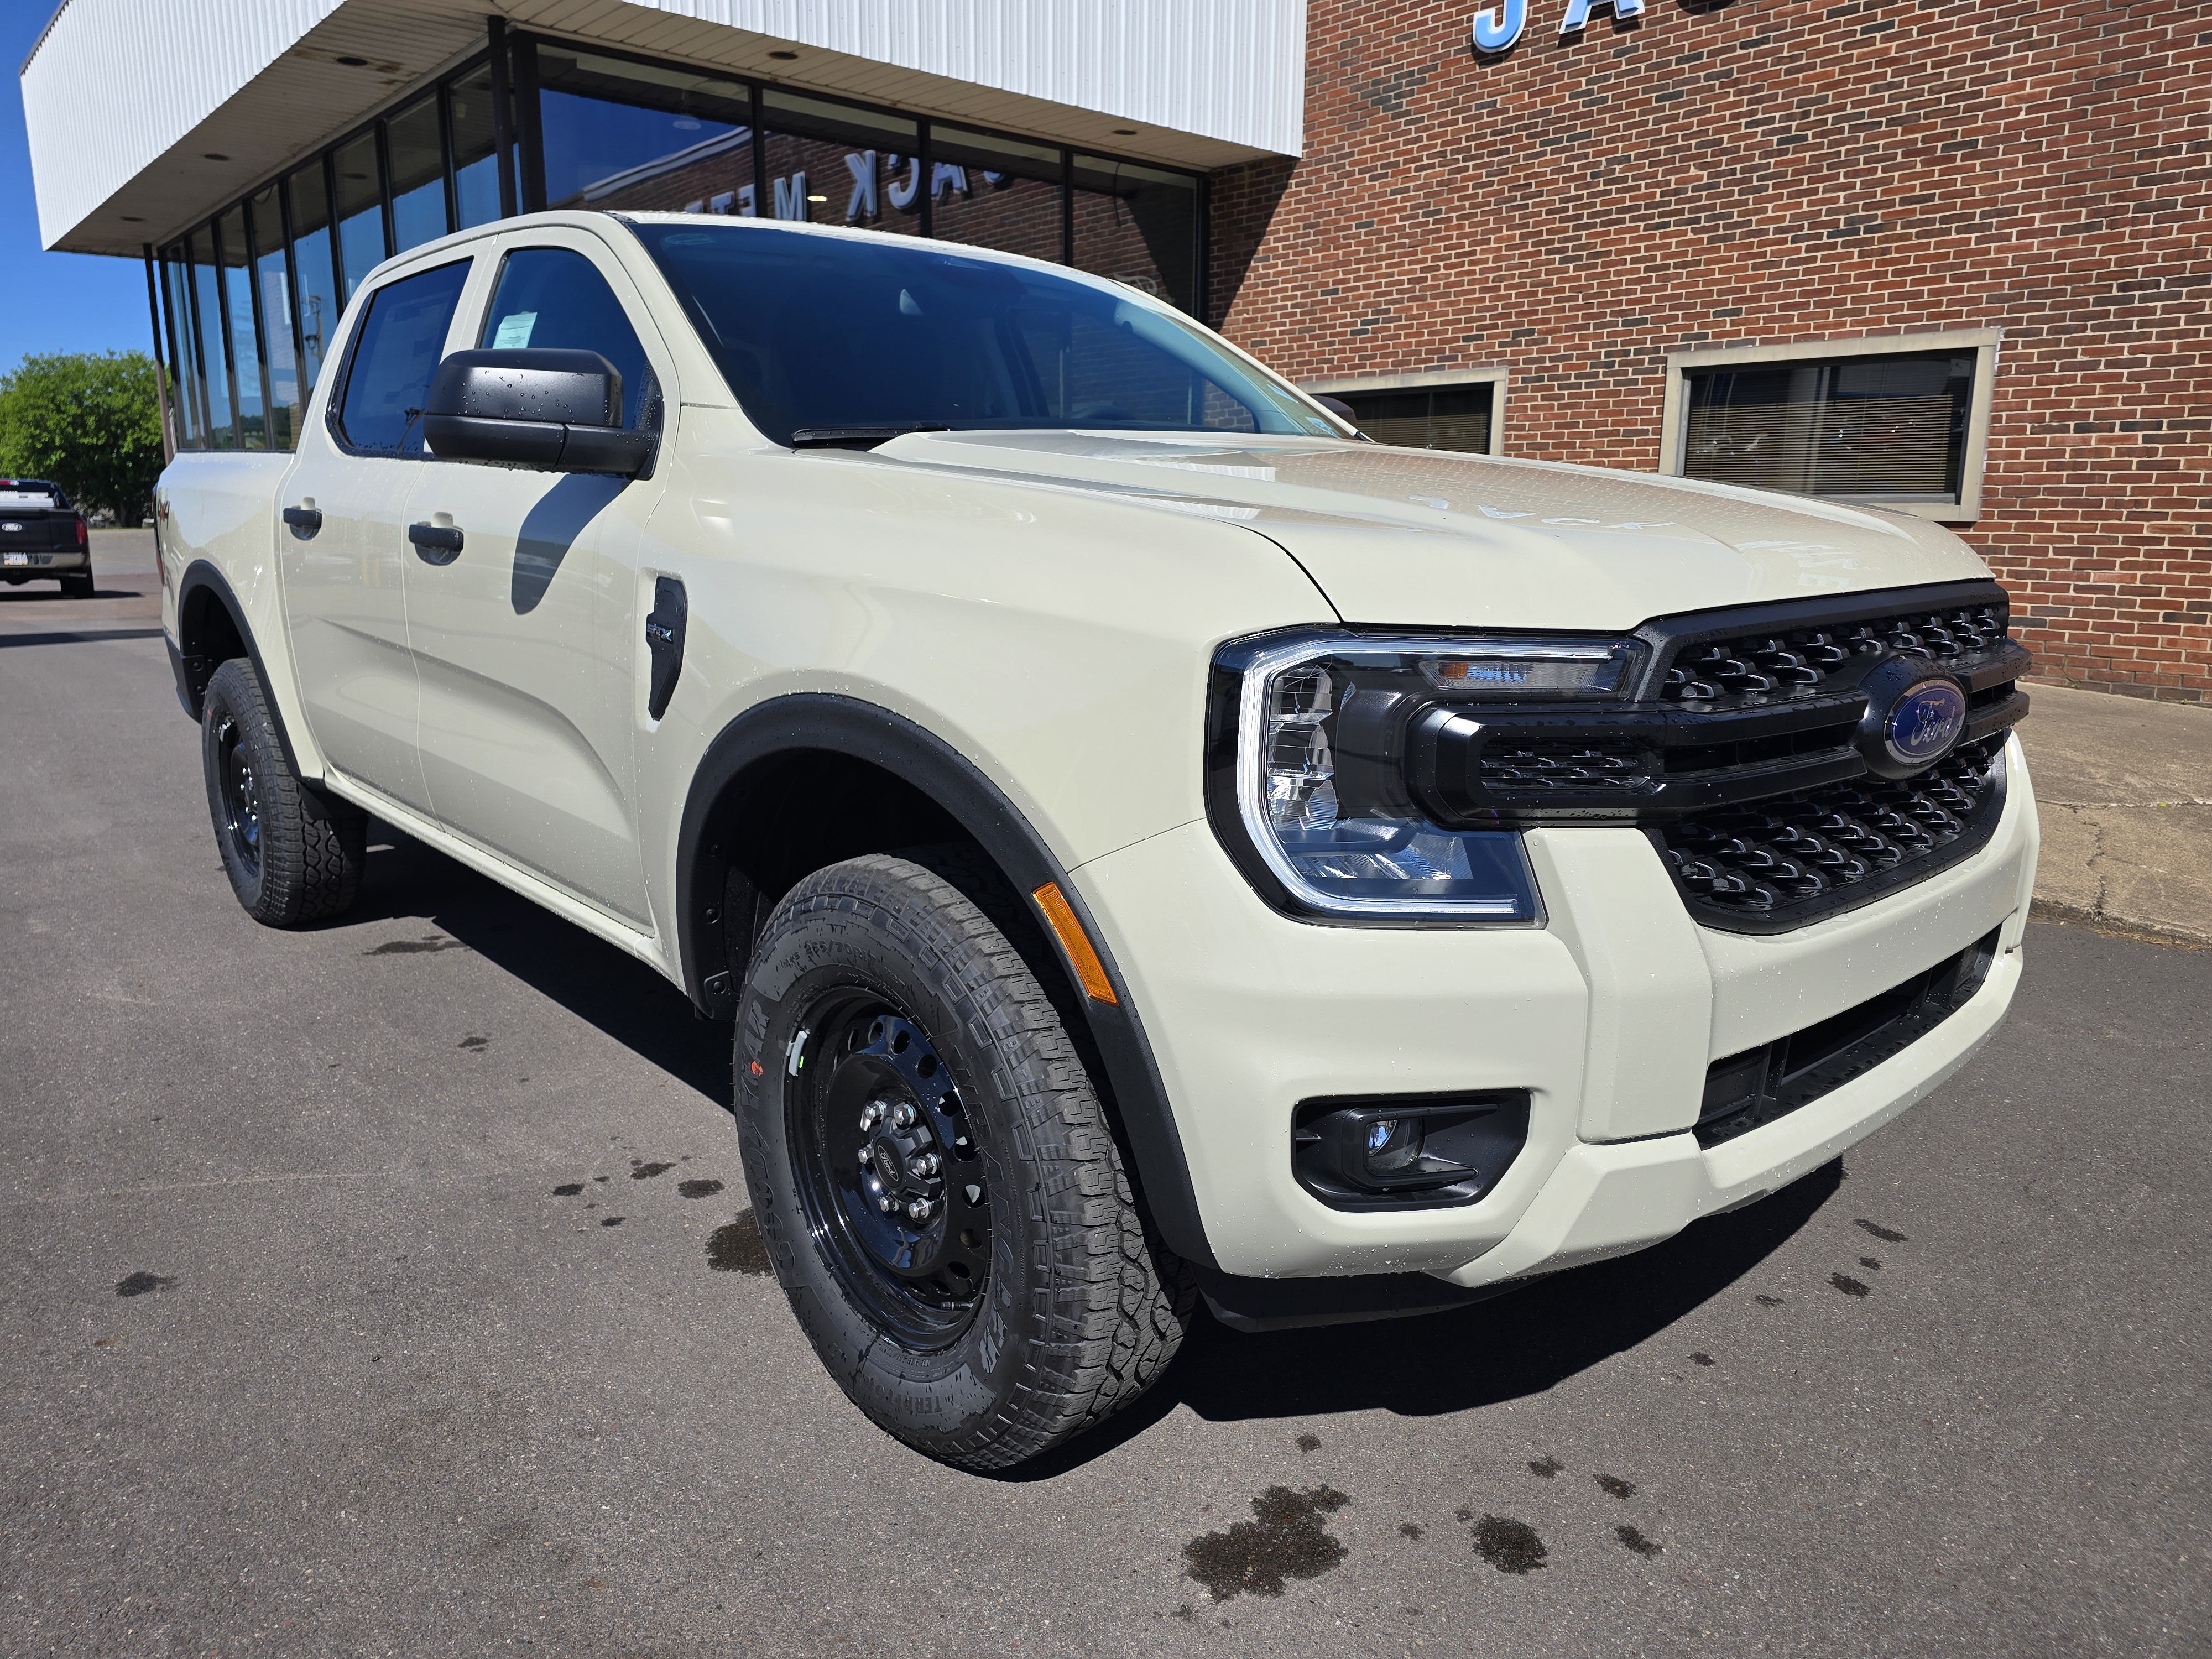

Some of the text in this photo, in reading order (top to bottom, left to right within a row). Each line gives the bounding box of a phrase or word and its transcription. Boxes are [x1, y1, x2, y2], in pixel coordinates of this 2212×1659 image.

[1910, 697, 1957, 747] Ford
[741, 999, 795, 1271] GOODYEAR
[879, 1152, 896, 1176] Ford
[948, 1045, 1014, 1374] WRANGLER
